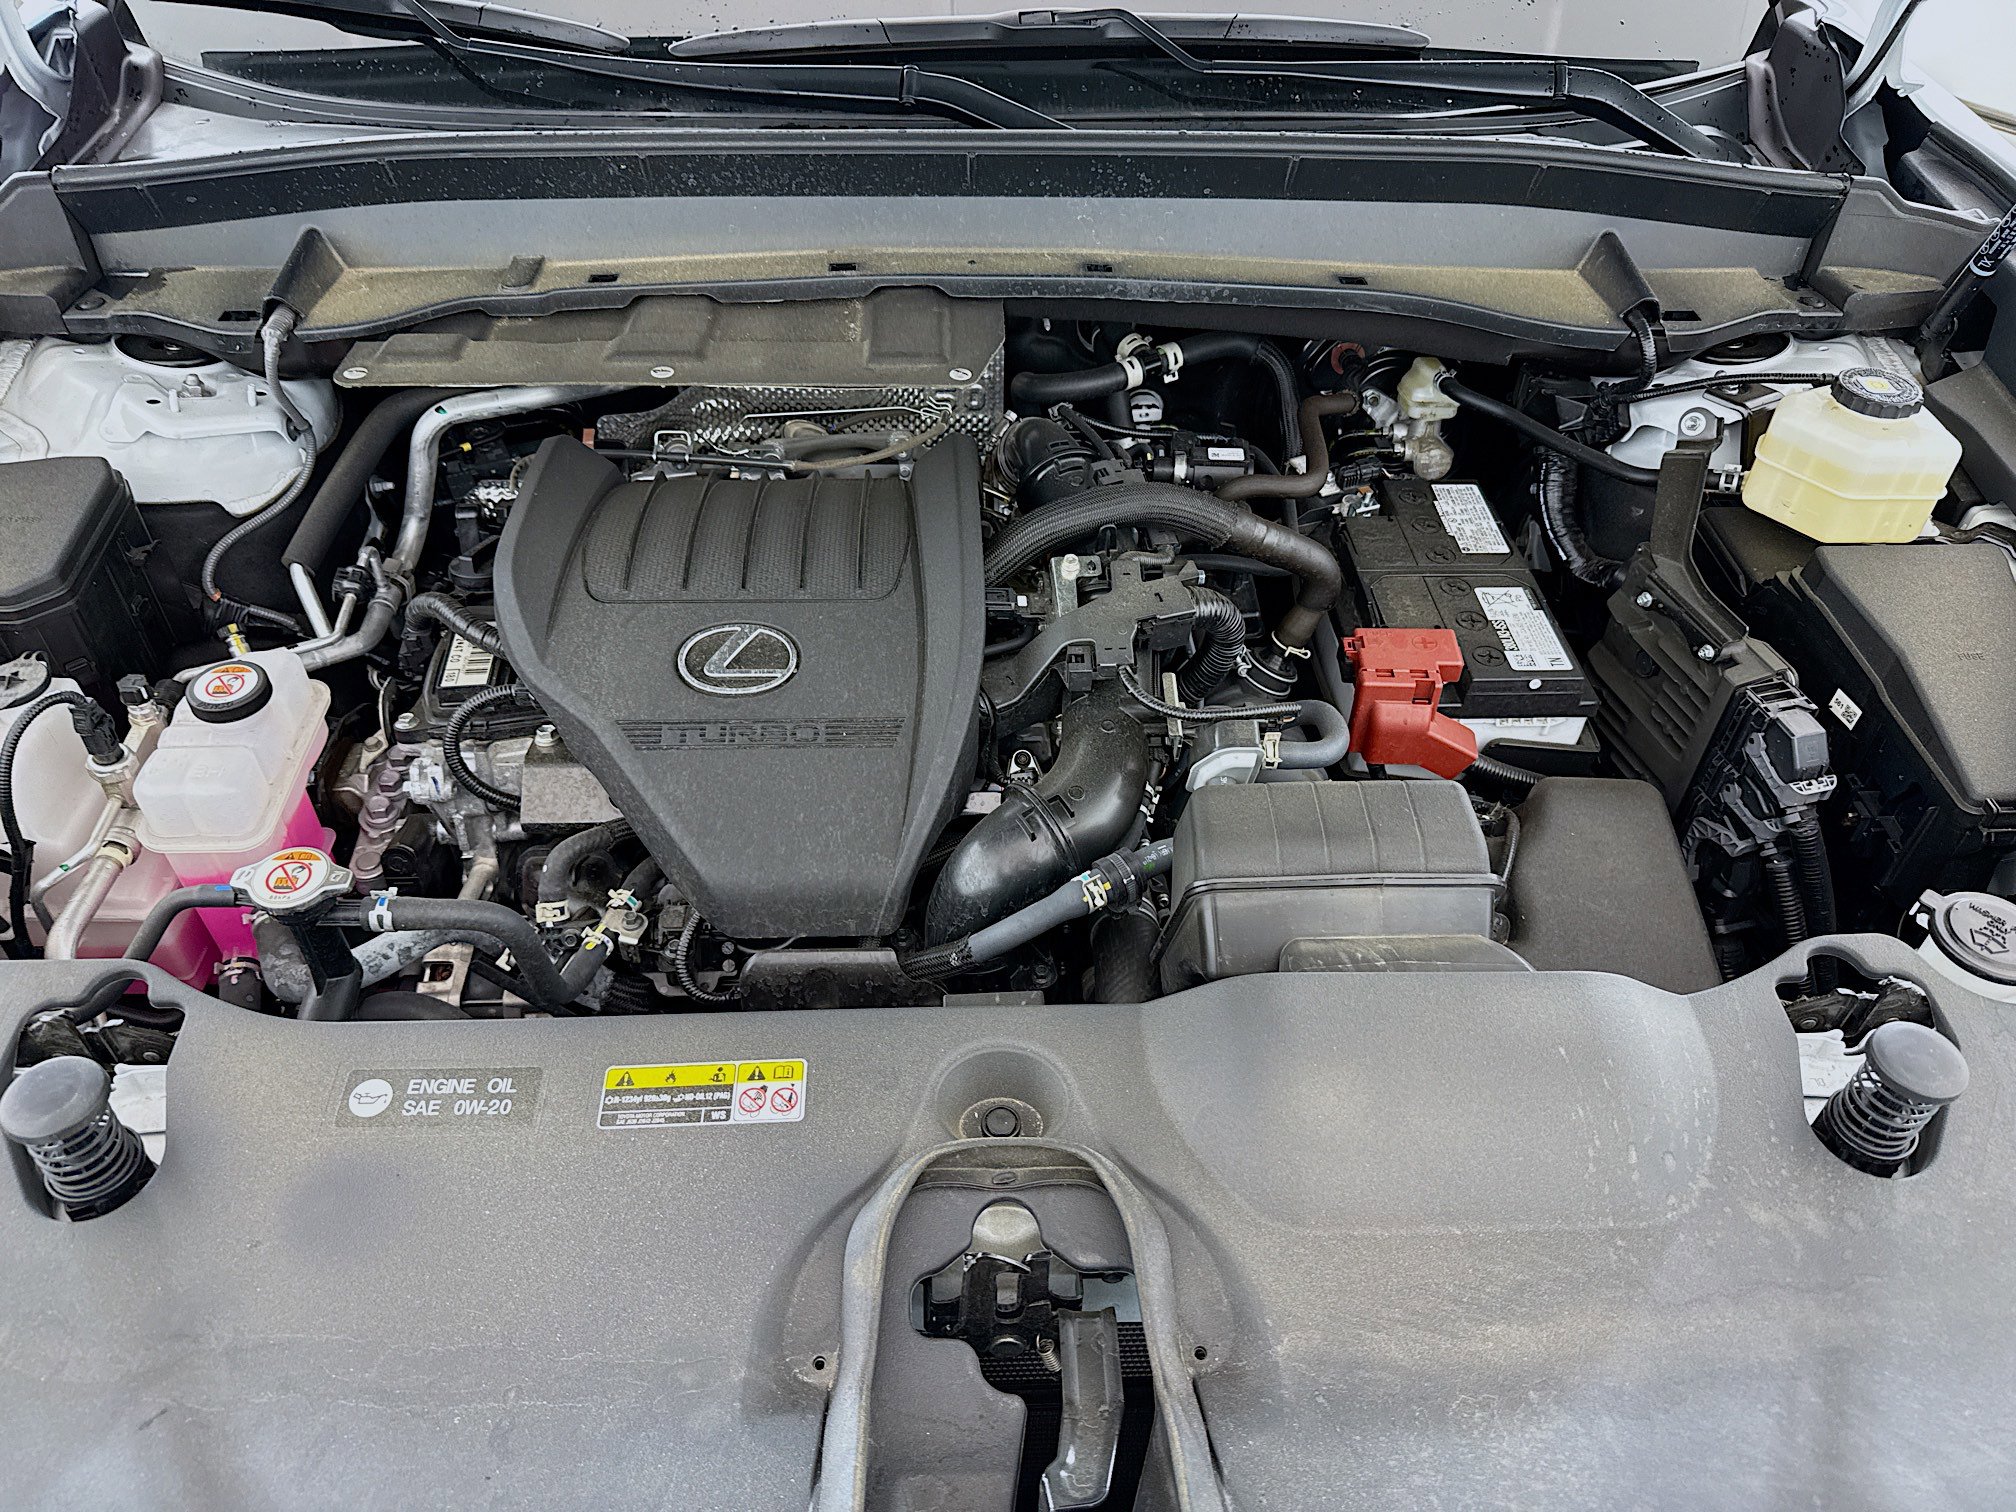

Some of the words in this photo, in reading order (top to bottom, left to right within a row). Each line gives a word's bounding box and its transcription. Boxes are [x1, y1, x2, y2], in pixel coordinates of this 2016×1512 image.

[667, 725, 820, 744] TURBO
[406, 1078, 477, 1094] ENGINE
[487, 1077, 517, 1094] OIL
[402, 1099, 441, 1116] SAE
[454, 1099, 512, 1116] 0W-20
[711, 1110, 727, 1120] WS
